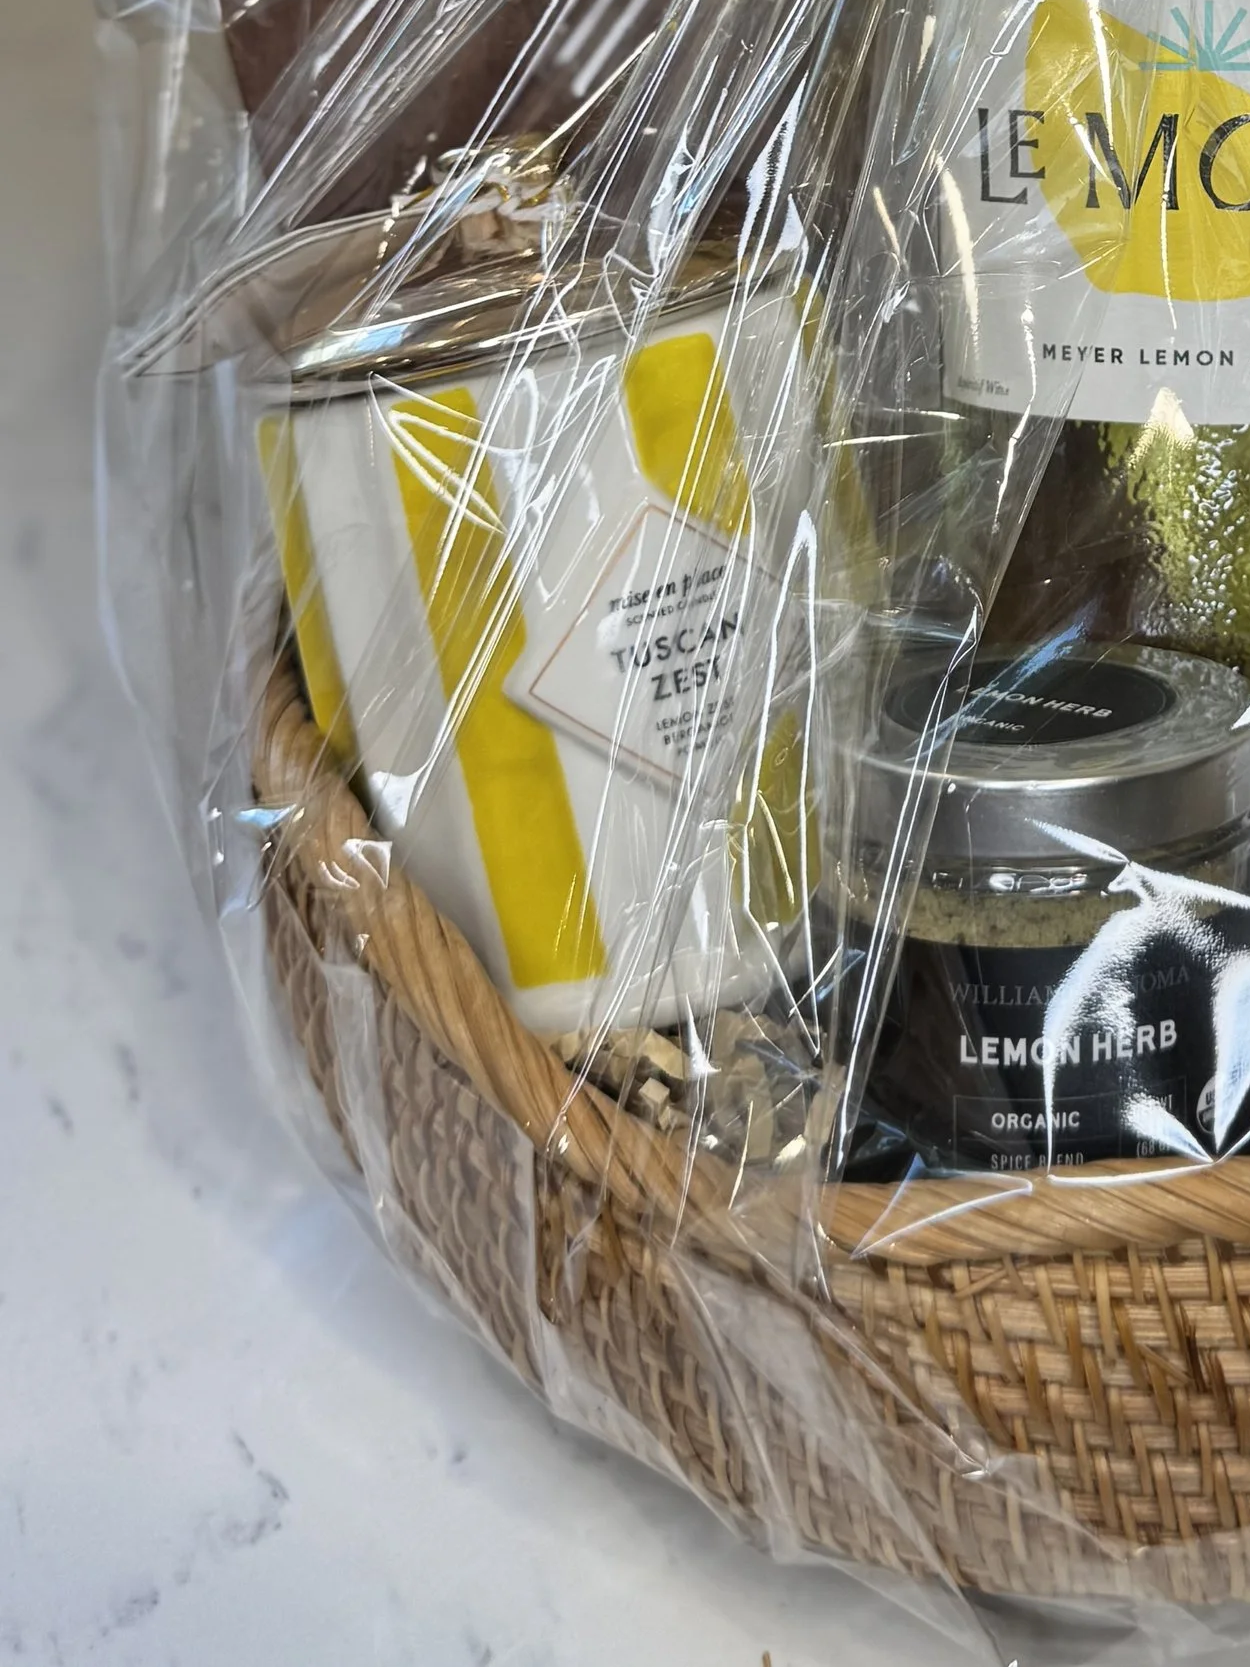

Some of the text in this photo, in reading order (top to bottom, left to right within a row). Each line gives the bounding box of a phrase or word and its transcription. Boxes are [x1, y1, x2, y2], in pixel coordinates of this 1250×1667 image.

[1041, 342, 1125, 366] MEYER
[1138, 345, 1235, 368] LEMON
[610, 612, 745, 674] TUSCAN
[650, 655, 722, 702] ZEST
[956, 685, 1113, 719] LEMON HERB
[959, 1018, 1178, 1067] LEMON HERB
[990, 1110, 1081, 1130] ORGANIC
[990, 1151, 1084, 1171] SPICE BEND
